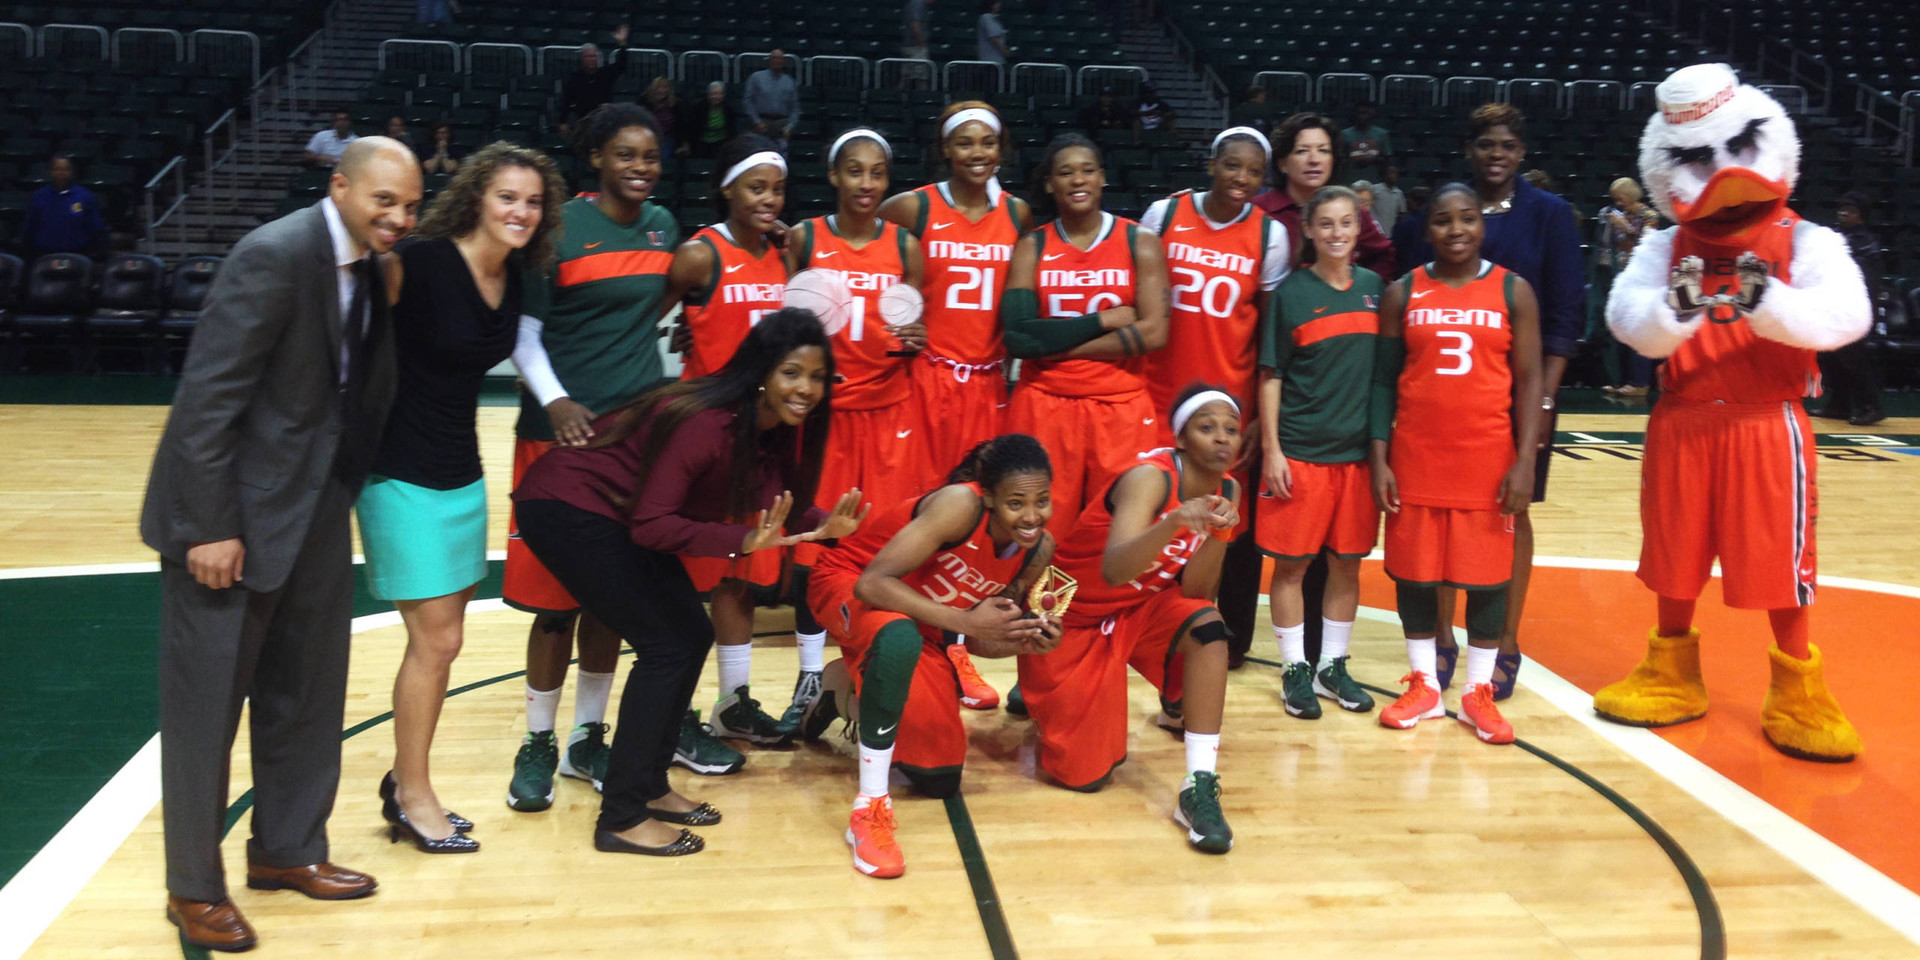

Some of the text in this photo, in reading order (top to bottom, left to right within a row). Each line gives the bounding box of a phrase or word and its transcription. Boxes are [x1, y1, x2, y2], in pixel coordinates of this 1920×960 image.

[945, 265, 995, 311] 21
[1171, 266, 1241, 318] 20
[849, 295, 866, 342] 1
[1435, 330, 1474, 375] 3
